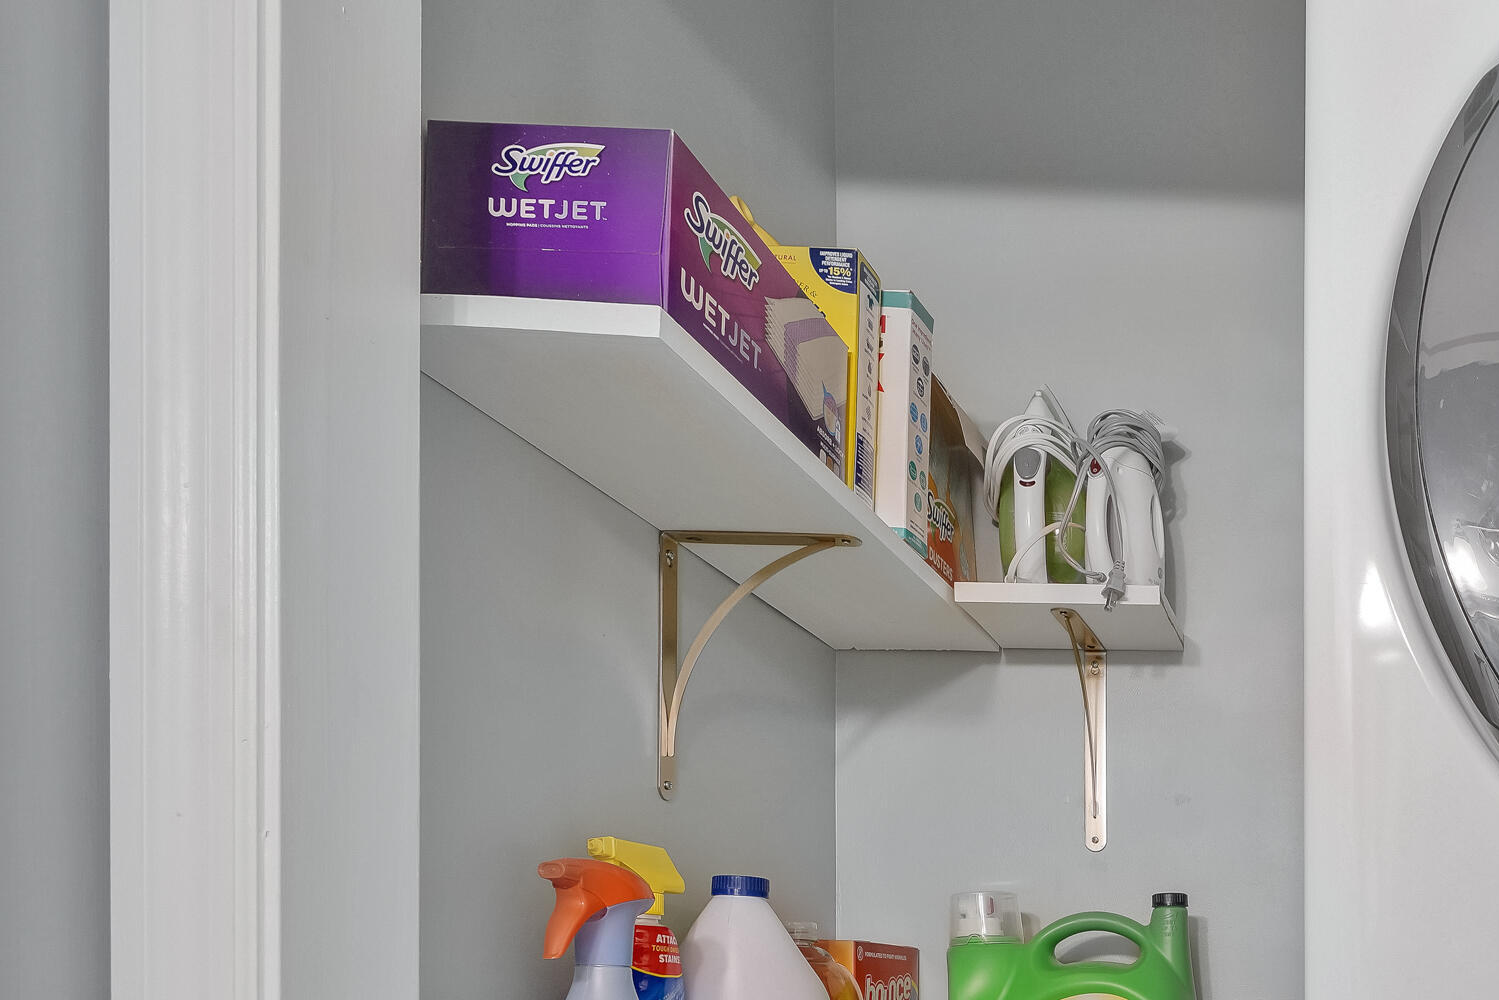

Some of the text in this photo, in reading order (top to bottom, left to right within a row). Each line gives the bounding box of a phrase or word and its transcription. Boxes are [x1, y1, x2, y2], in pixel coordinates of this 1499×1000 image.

[492, 145, 600, 184] Swiffer
[488, 197, 607, 220] WETJET
[684, 192, 760, 291] Swiffer
[681, 267, 762, 369] WETJET
[927, 491, 954, 542] Swiffer
[929, 549, 953, 581] DUSTERS
